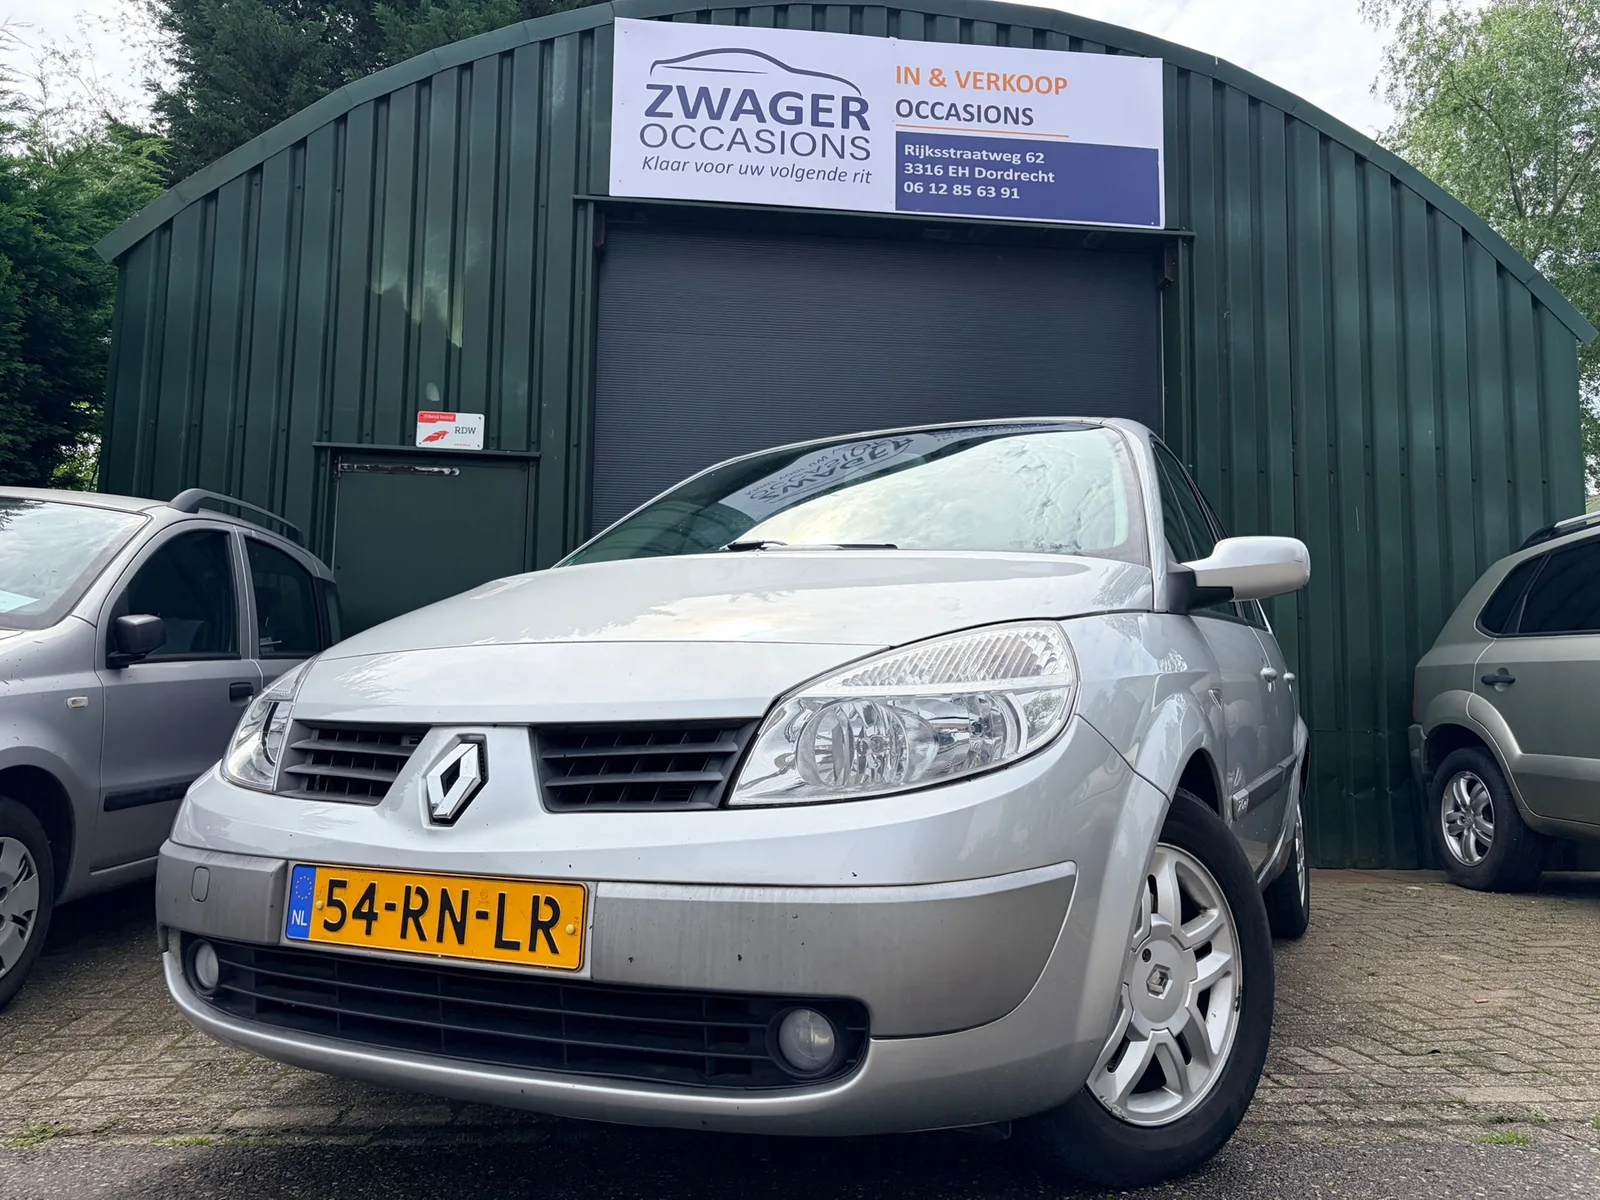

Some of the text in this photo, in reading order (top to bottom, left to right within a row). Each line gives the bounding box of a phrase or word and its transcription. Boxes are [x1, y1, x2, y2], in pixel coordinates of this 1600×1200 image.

[896, 66, 1068, 96] IN & VERKOOP
[644, 83, 871, 132] ZWAGER
[895, 98, 1034, 127] OCCASIONS
[639, 123, 871, 161] OCCASIONS
[904, 144, 1045, 165] Rijksstraatweg 62
[642, 155, 873, 184] Klaar voor uw volgende rit
[904, 163, 1055, 183] 3316 EH Dordrecht
[903, 181, 1020, 199] 06 12 85 63 91
[454, 426, 476, 435] RDW
[291, 909, 308, 927] NL
[322, 877, 561, 955] 54-RN-LR
